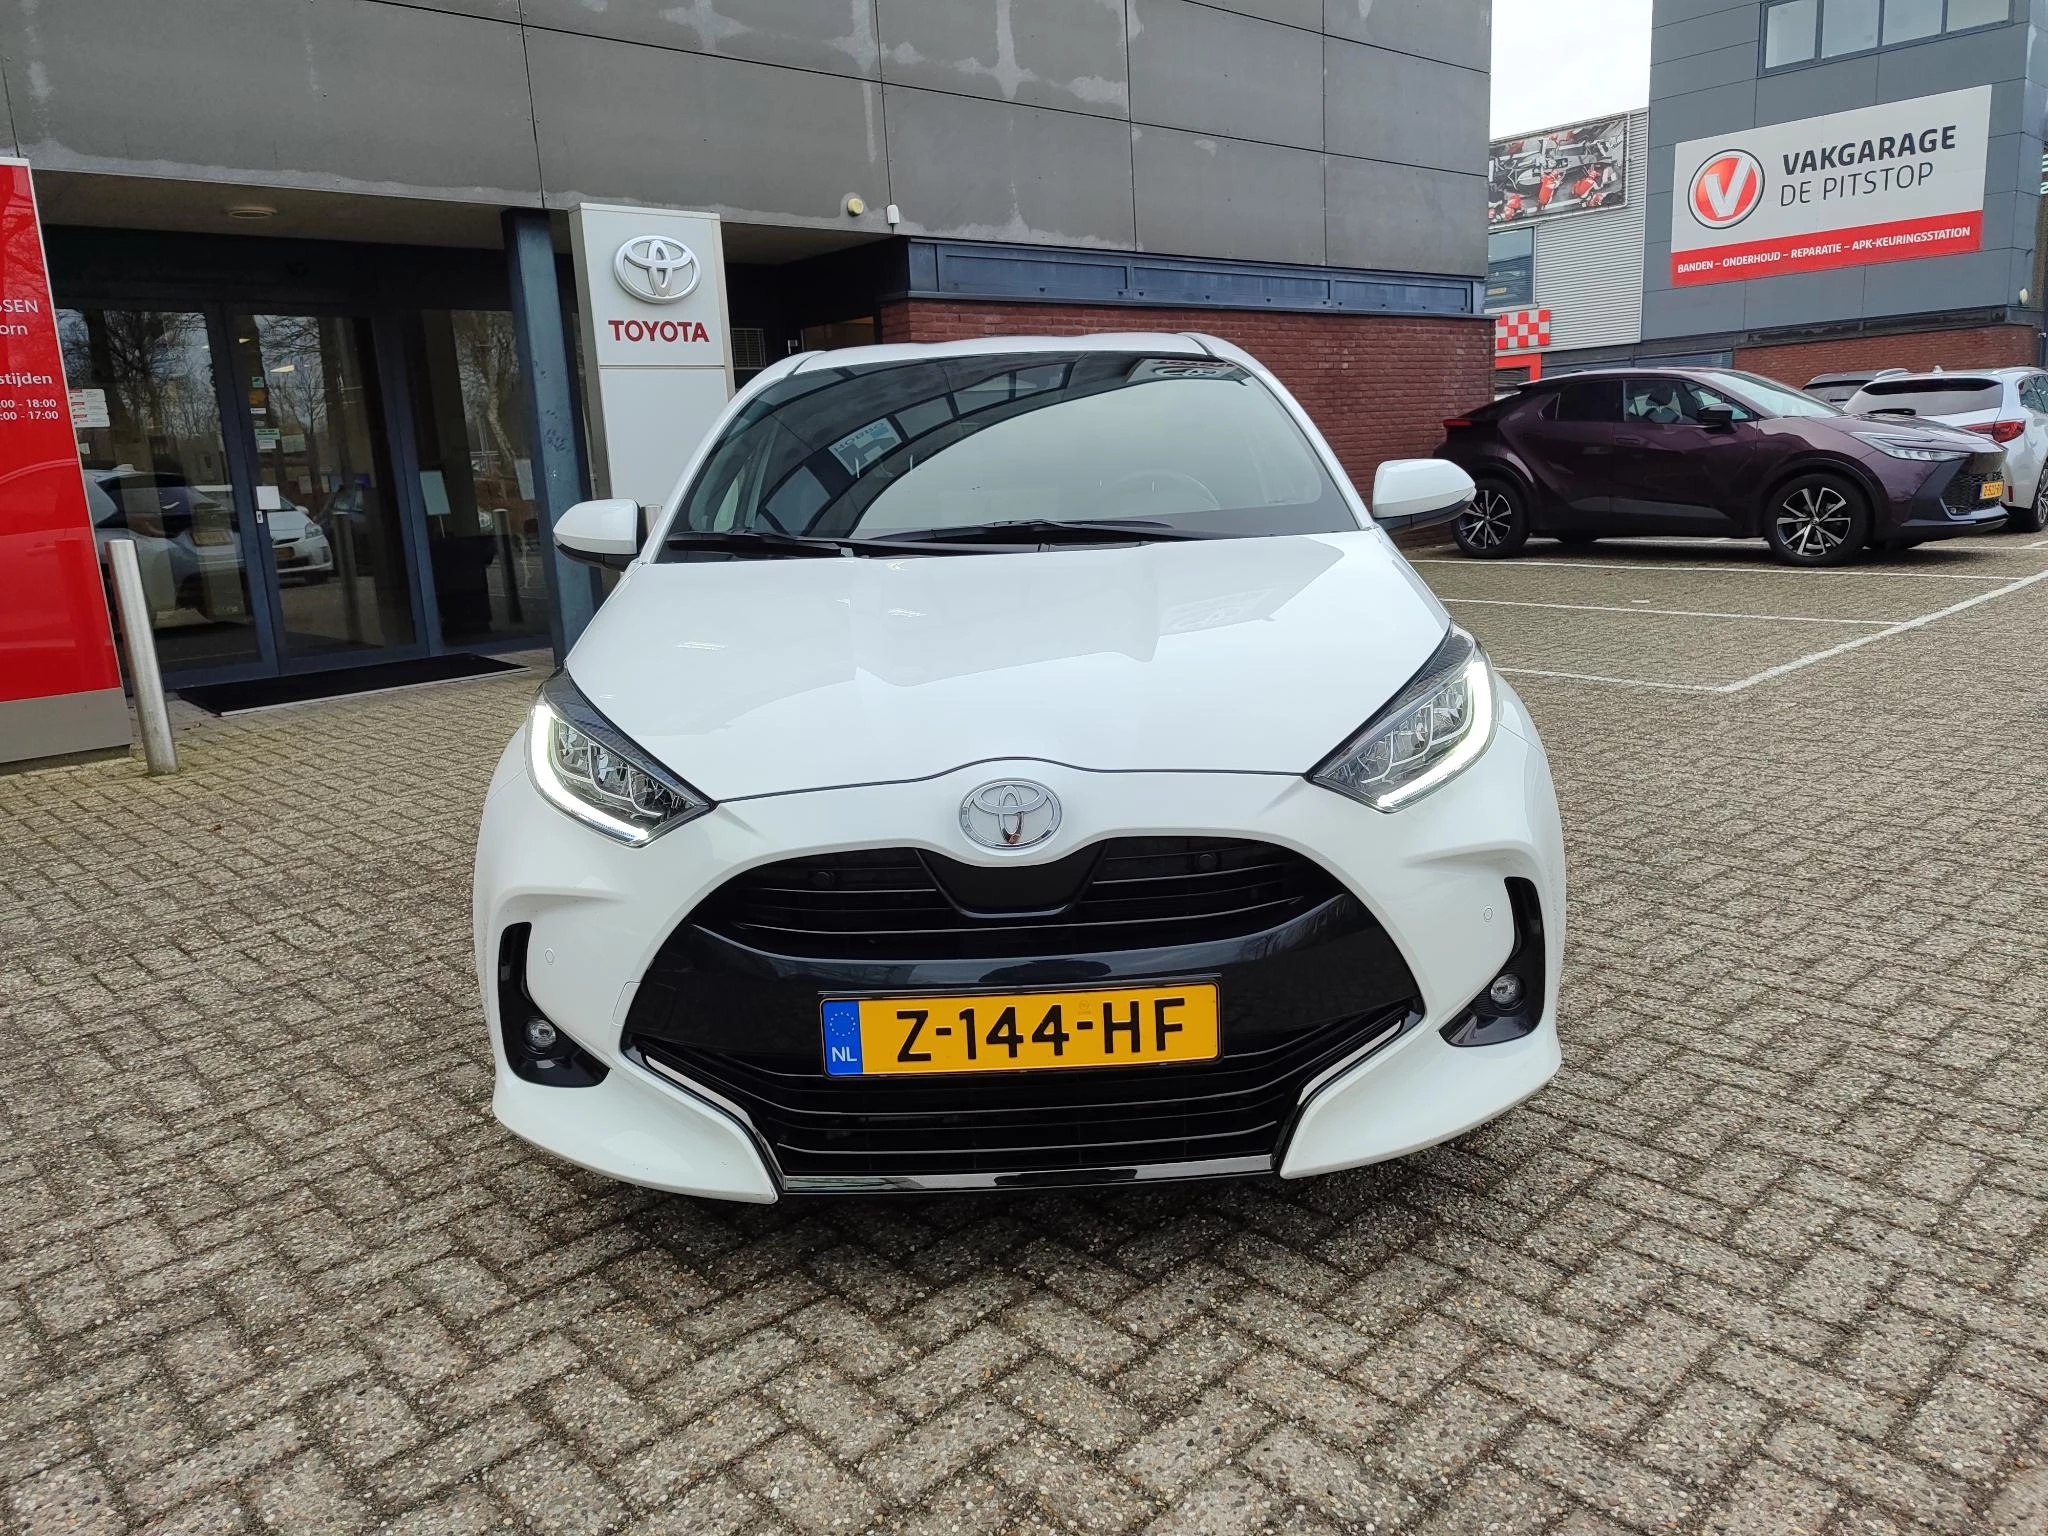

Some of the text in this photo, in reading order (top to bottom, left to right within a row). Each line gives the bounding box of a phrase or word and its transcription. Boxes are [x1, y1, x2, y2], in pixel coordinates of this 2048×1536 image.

[1783, 125, 1957, 176] VAKGARAGE
[1780, 161, 1934, 207] DE PITSTOP
[1677, 260, 1714, 274] BANDEN
[1722, 251, 1781, 268] ONDERHOUD
[1791, 243, 1842, 258] REPARATIE
[1852, 226, 1971, 251] APK-KEURINGSSTATION
[0, 299, 38, 313] SEN
[608, 320, 710, 343] TOYOTA
[26, 399, 57, 408] 18:00
[28, 411, 59, 420] 17:00
[896, 997, 1186, 1063] Z-144-HF
[831, 1046, 858, 1063] NL
